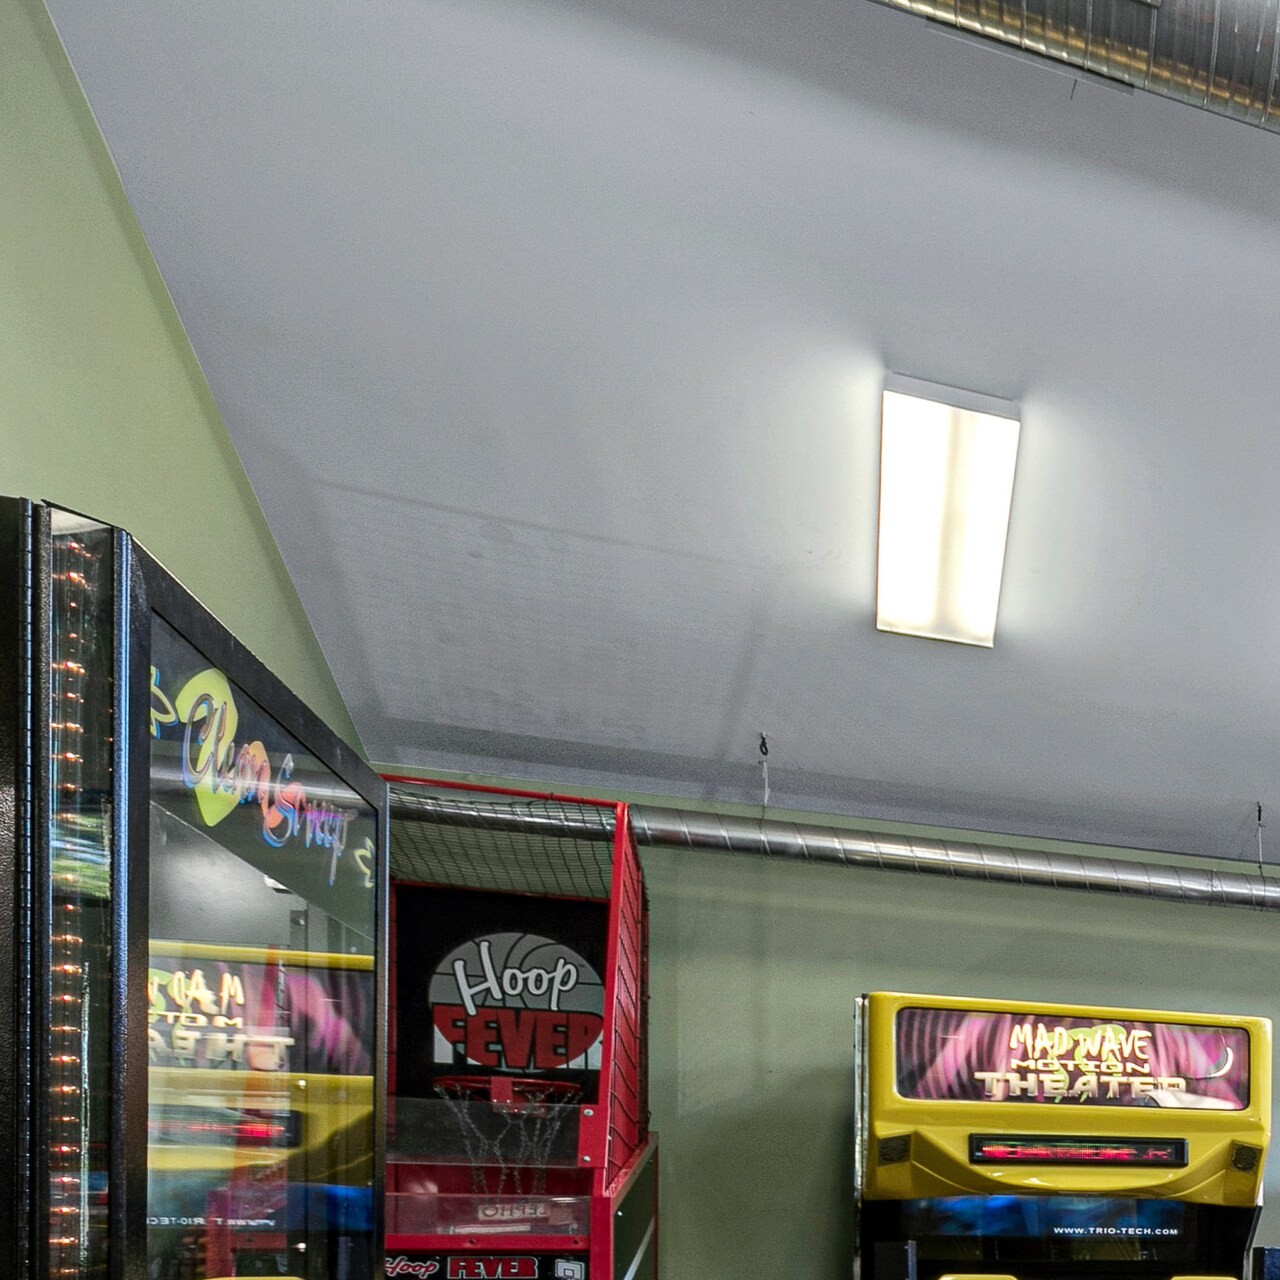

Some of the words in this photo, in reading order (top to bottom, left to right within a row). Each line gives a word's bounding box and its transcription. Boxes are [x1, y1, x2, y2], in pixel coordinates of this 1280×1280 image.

[452, 940, 578, 1016] Hoop
[432, 1004, 604, 1070] FEVER
[1009, 1022, 1069, 1057] MAD
[1077, 1024, 1152, 1061] WAVE
[1010, 1057, 1151, 1073] MOTION
[1053, 1226, 1178, 1236] WWW.TRIO-TECH.COM
[385, 1256, 439, 1279] Hoop
[447, 1256, 538, 1279] FEVER
